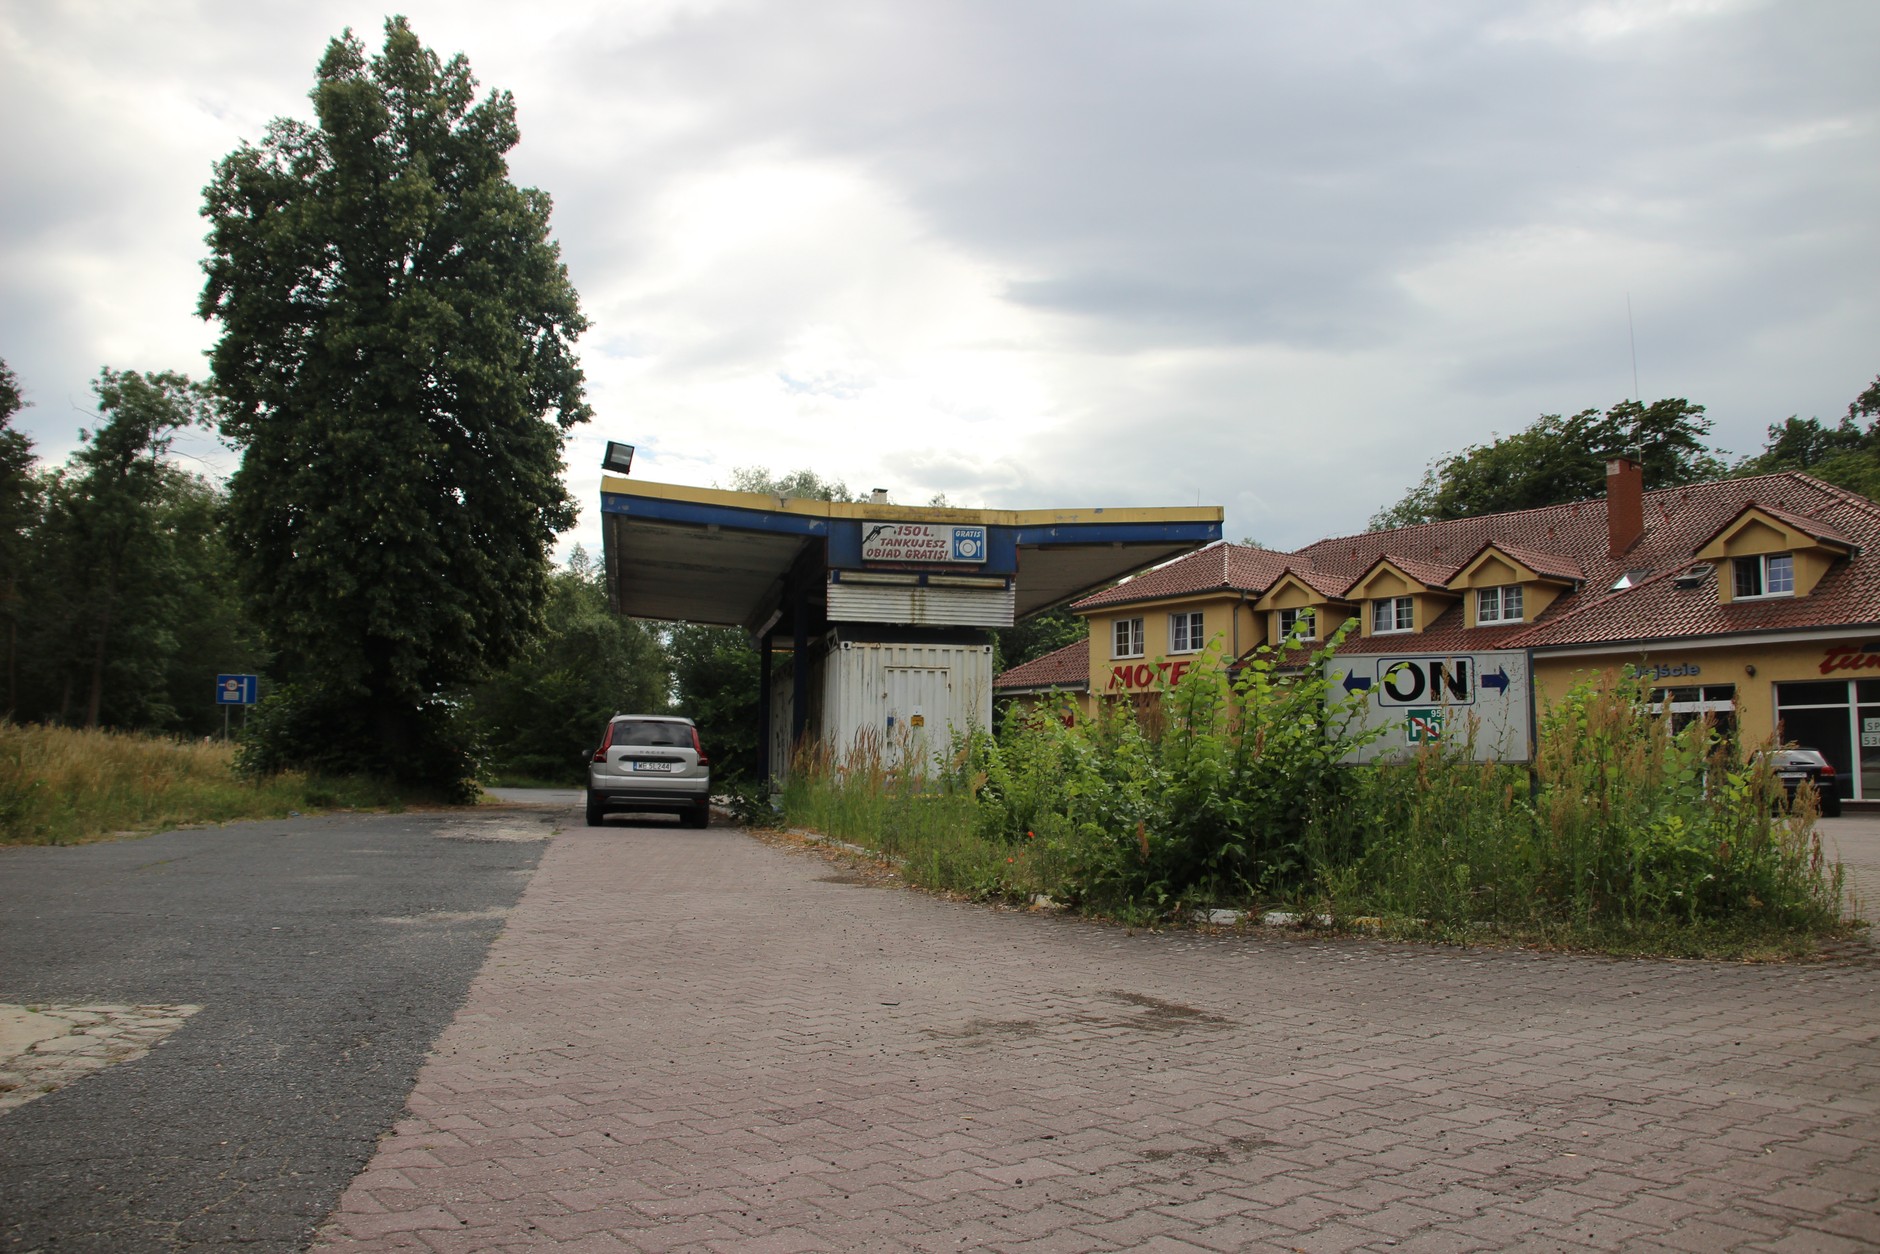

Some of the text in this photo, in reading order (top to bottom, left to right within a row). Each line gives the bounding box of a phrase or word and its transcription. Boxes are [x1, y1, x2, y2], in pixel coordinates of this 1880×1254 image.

[897, 526, 921, 536] 150
[880, 538, 946, 548] TANKUJESZ
[866, 548, 949, 560] OBIAD GRATIS!
[1109, 661, 1201, 689] MOTE
[1384, 661, 1467, 702] ON
[1431, 709, 1441, 718] 95
[1411, 717, 1440, 737] Pb
[1864, 736, 1880, 745] 53
